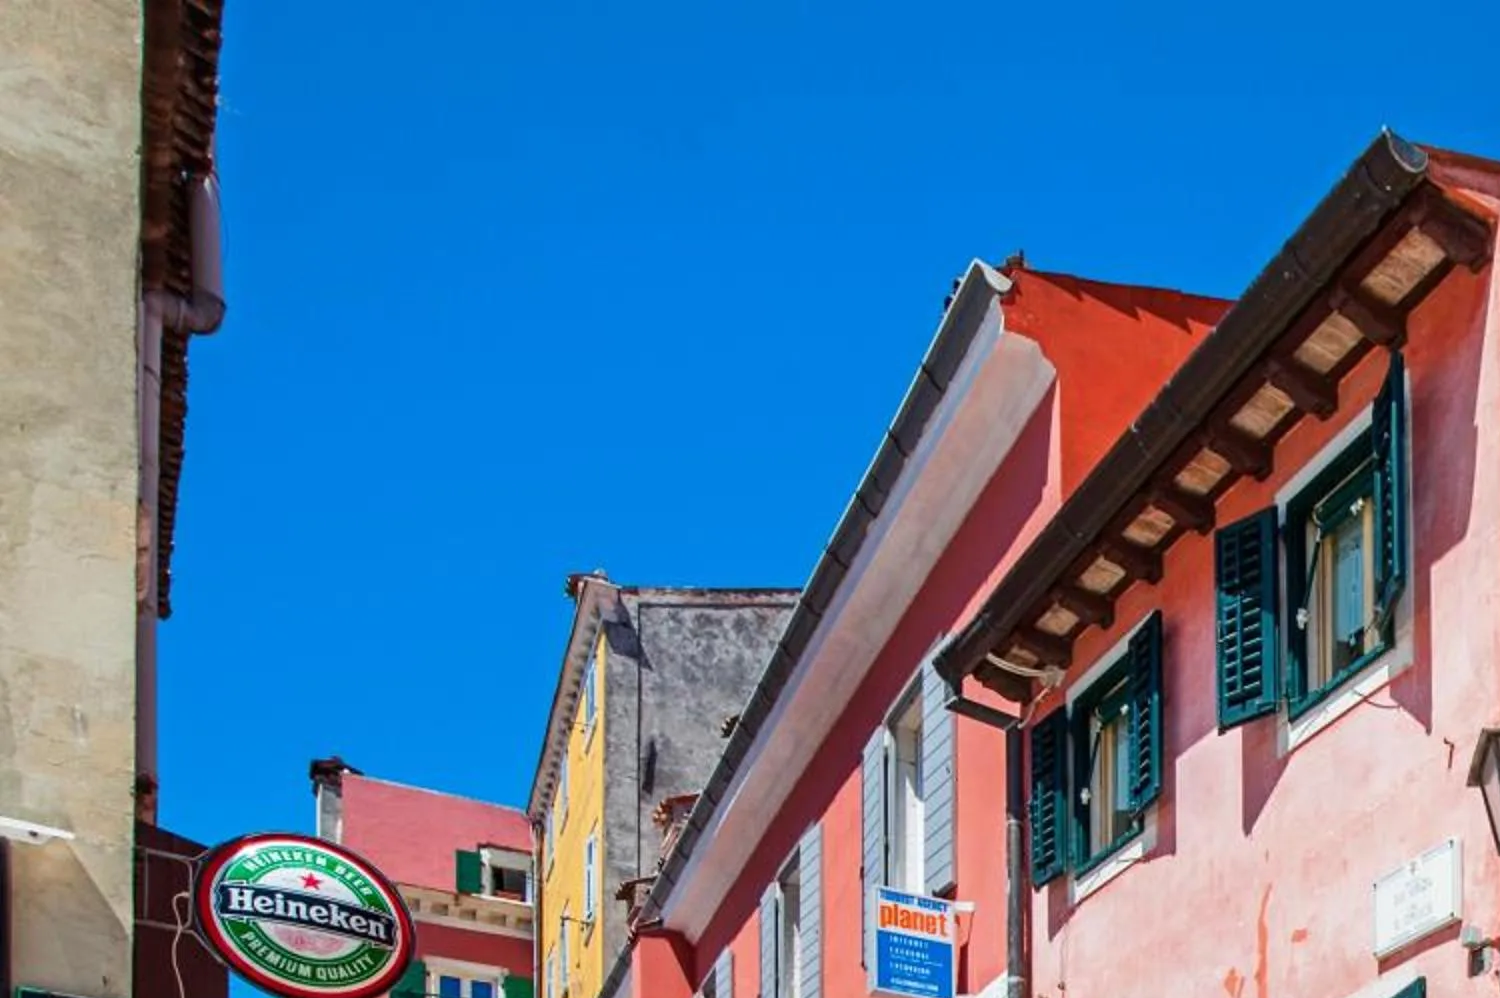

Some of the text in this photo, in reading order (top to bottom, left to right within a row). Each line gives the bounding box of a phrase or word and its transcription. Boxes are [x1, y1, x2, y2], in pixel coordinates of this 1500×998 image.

[243, 850, 373, 896] HEINEKEN BEER
[228, 887, 387, 940] Heineken
[880, 903, 948, 937] planet
[241, 931, 376, 981] PREMIUM QUALITY
